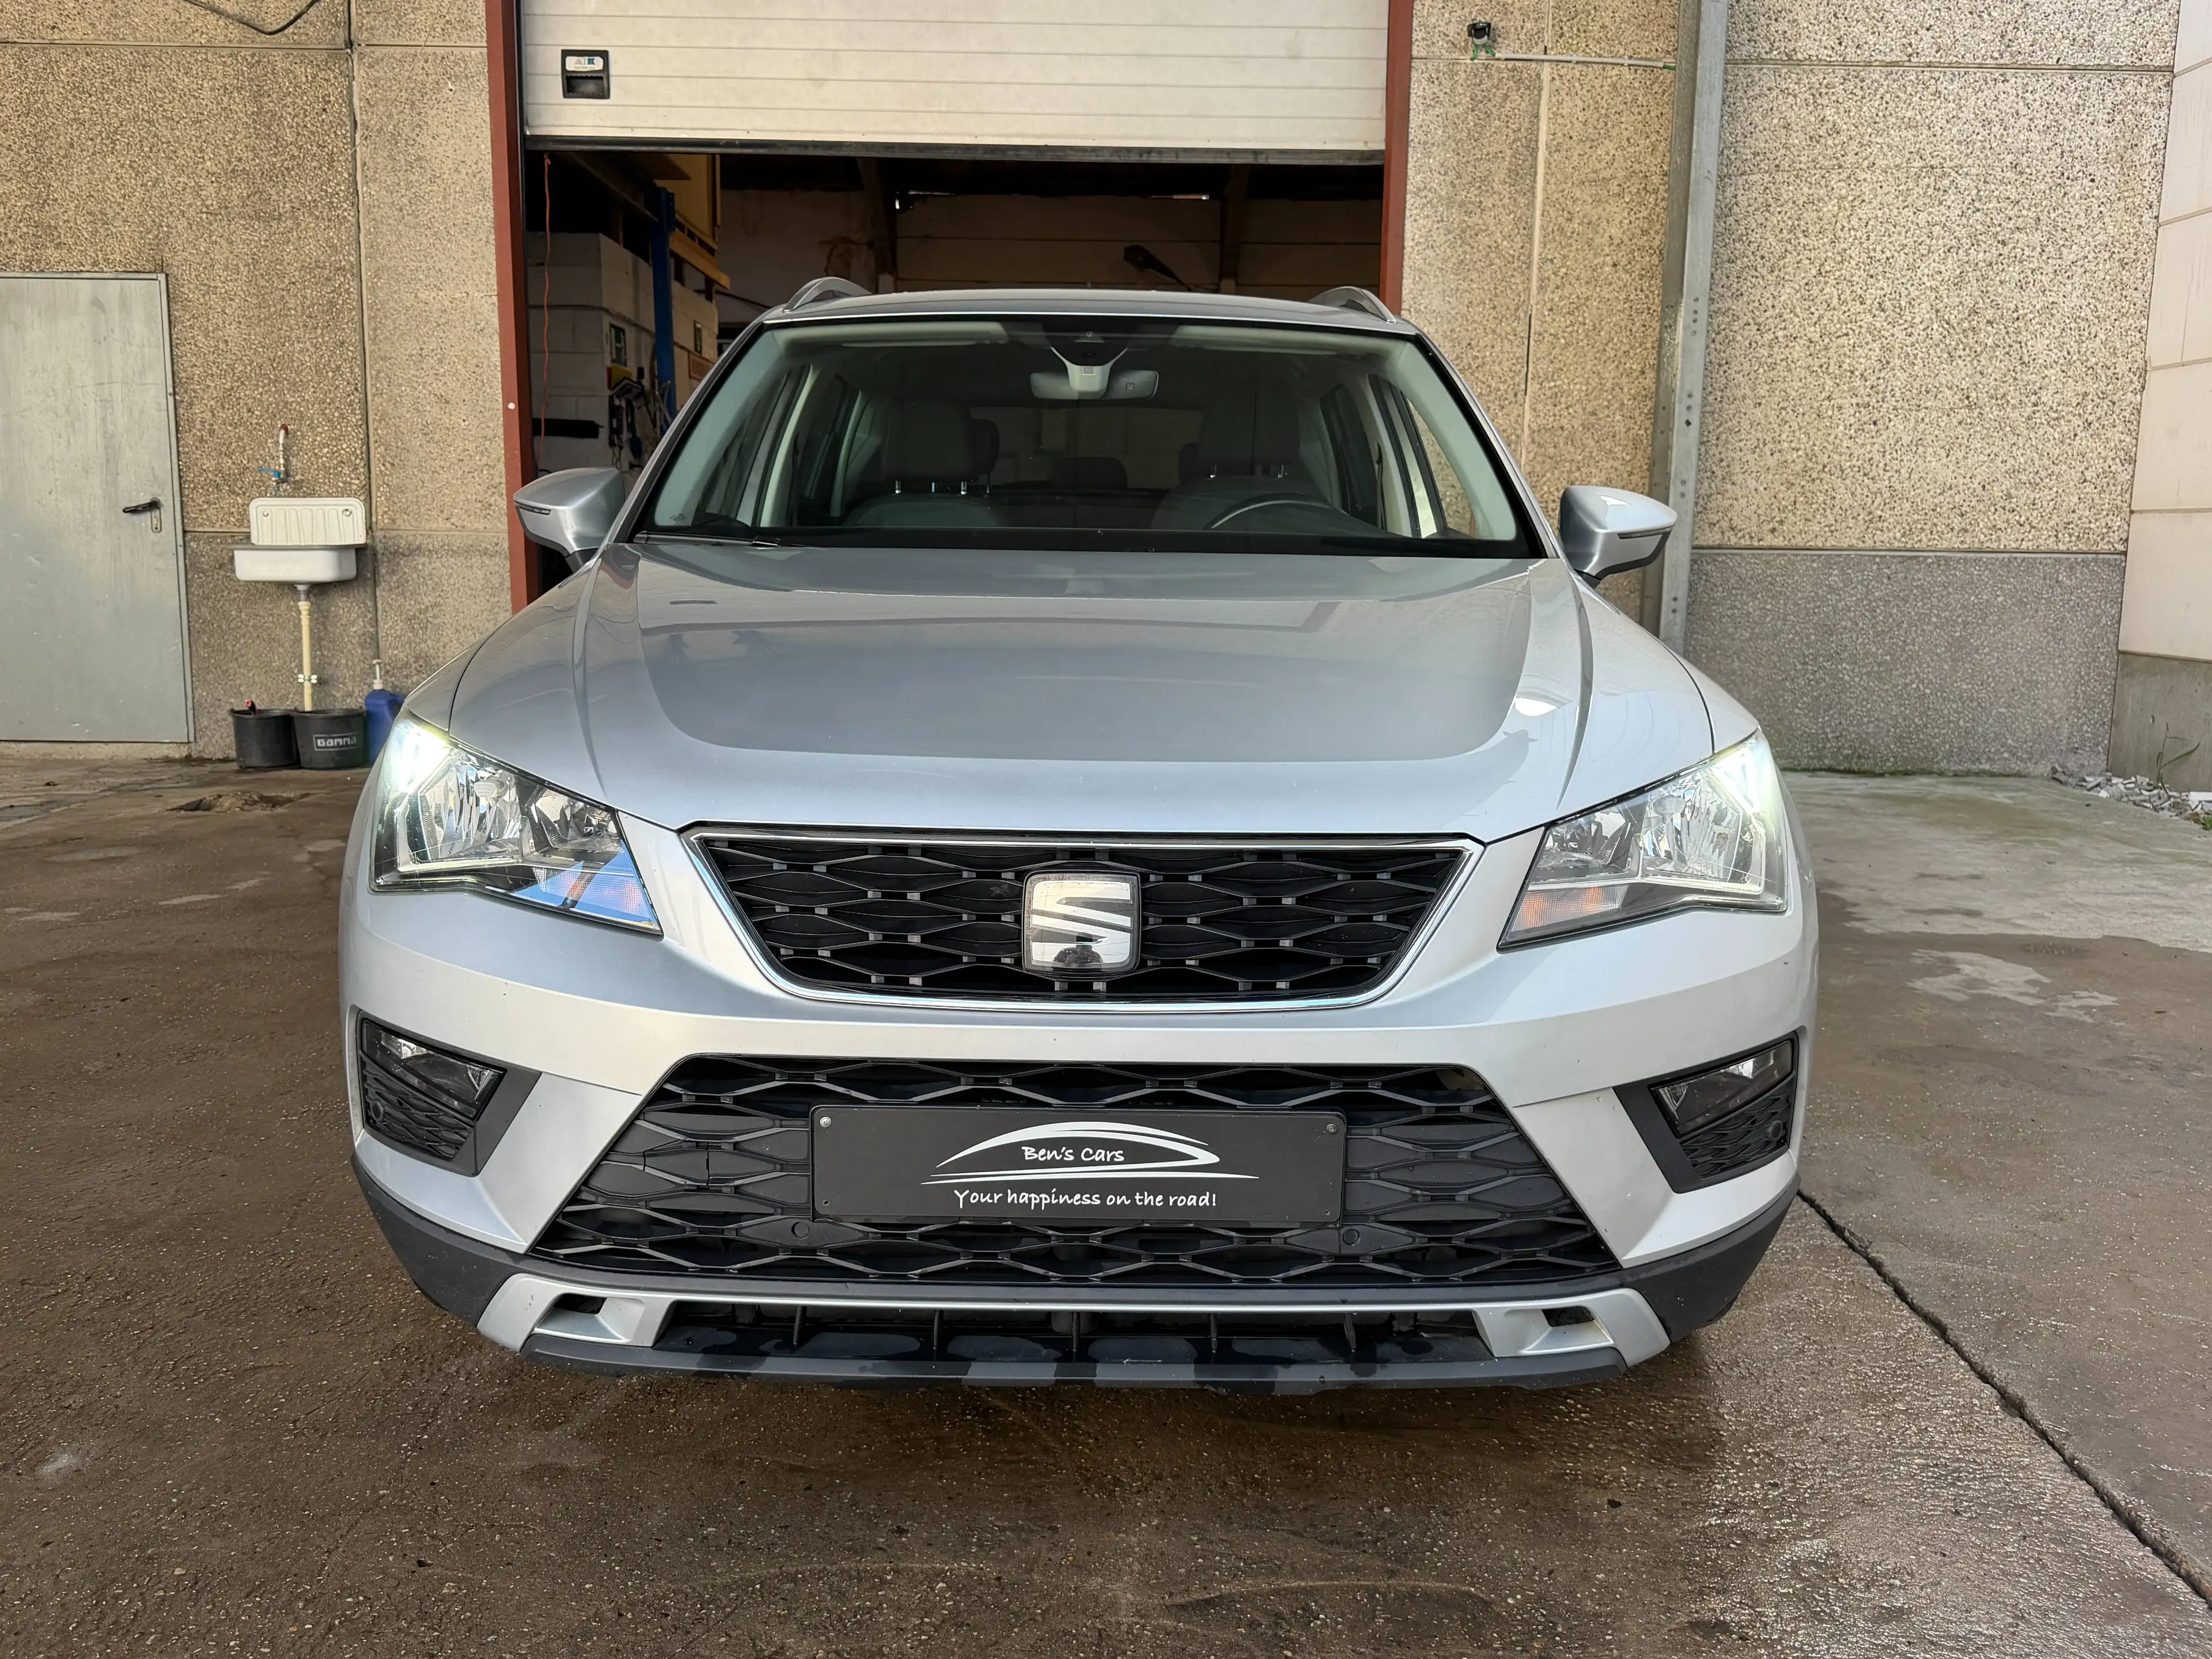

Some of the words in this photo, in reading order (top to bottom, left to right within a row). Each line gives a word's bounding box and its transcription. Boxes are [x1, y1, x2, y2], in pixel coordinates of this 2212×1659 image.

[1021, 1146, 1075, 1162] Ben's
[1081, 1147, 1125, 1162] Cars
[954, 1190, 1003, 1210] Your
[1007, 1188, 1101, 1211] happiness
[1106, 1195, 1131, 1206] on
[1134, 1191, 1164, 1206] the
[1169, 1191, 1217, 1207] road!
